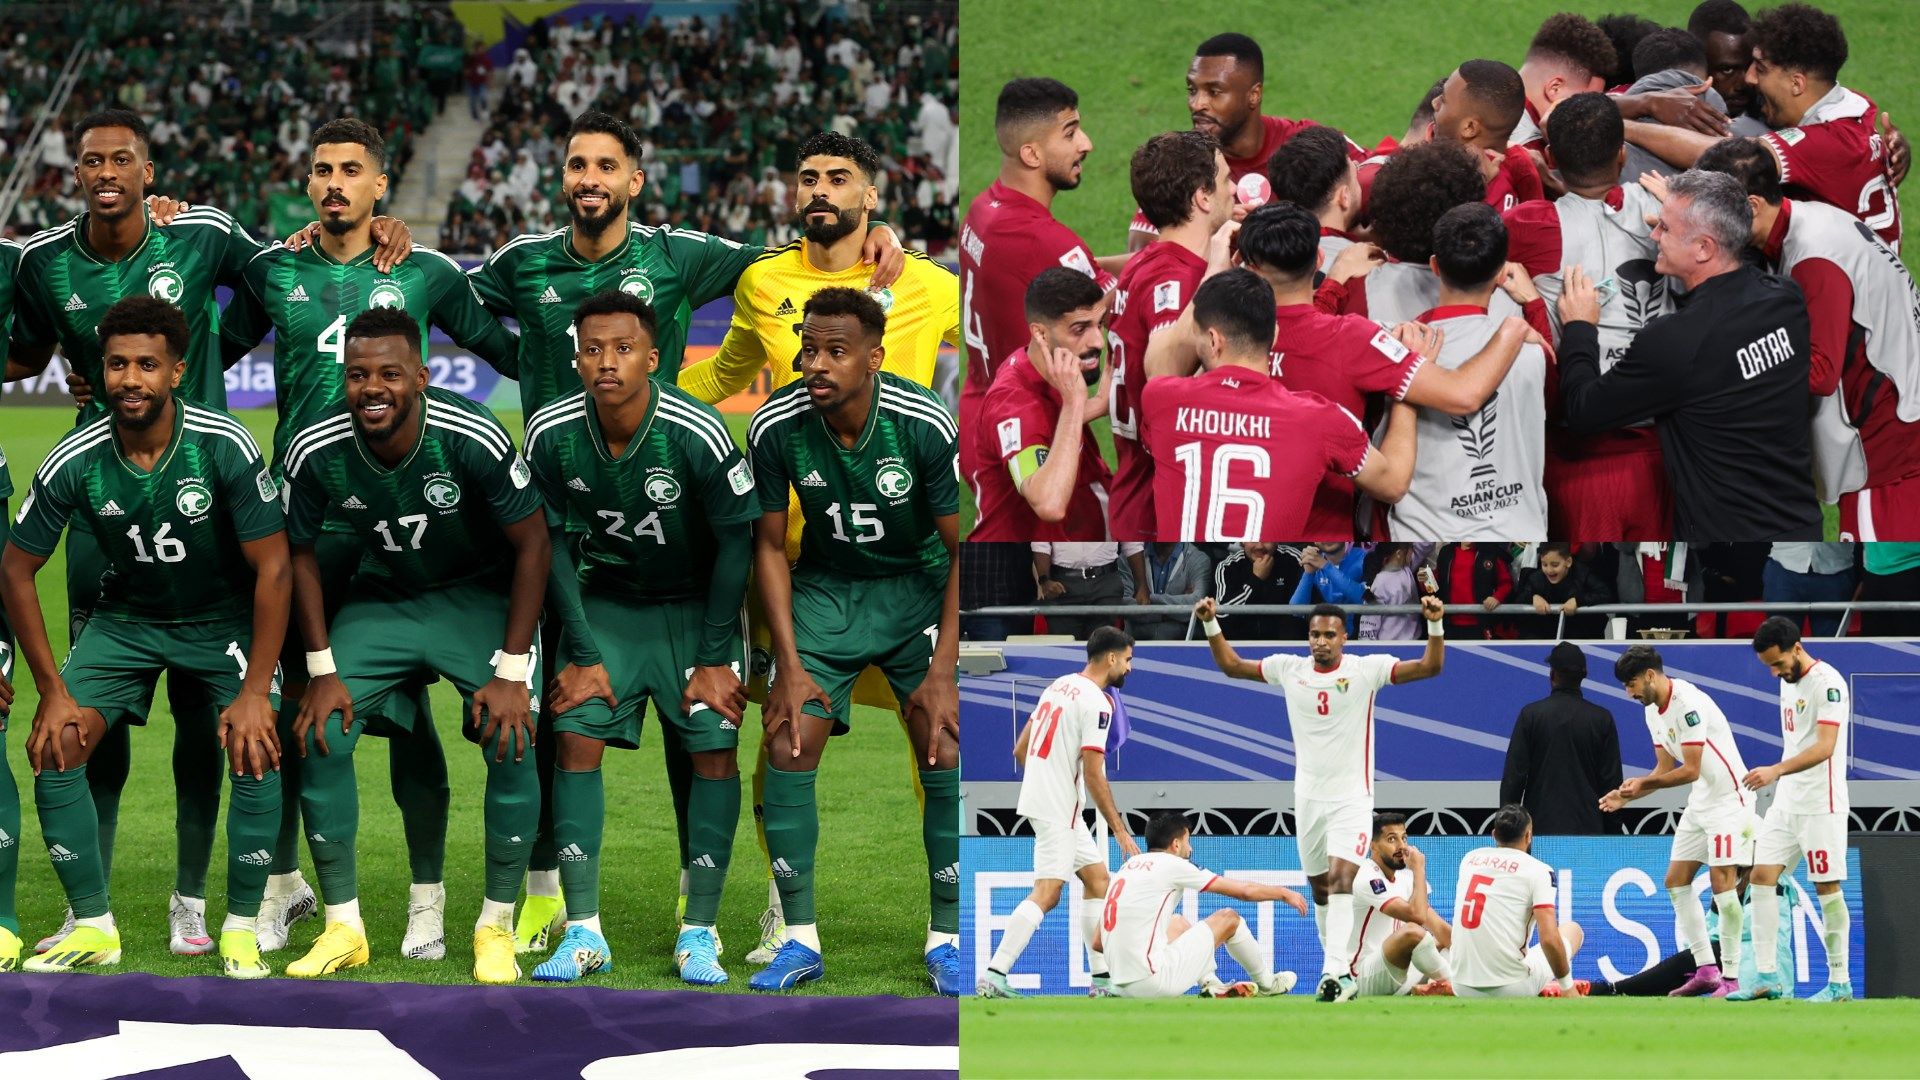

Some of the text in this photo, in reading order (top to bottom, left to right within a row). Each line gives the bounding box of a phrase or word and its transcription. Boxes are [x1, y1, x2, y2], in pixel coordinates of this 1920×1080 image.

[317, 314, 347, 364] 4
[1736, 327, 1795, 380] QATAR
[1175, 407, 1271, 438] KHOUKHI
[1175, 441, 1271, 542] 16
[1450, 483, 1523, 508] ASIAN CUP
[1475, 479, 1495, 491] AFC
[889, 497, 909, 507] SAUDI
[1456, 503, 1491, 518] QATAR
[373, 513, 428, 552] 17
[596, 511, 666, 545] 24
[825, 502, 885, 543] 15
[126, 522, 187, 563] 16
[1317, 691, 1329, 716] 3
[1784, 707, 1794, 732] 13
[1029, 701, 1063, 760] 21
[1355, 832, 1367, 857] 3
[1714, 834, 1732, 858] 11
[1807, 850, 1829, 874] 13
[1104, 878, 1125, 932] 8
[1461, 874, 1495, 929] 5
